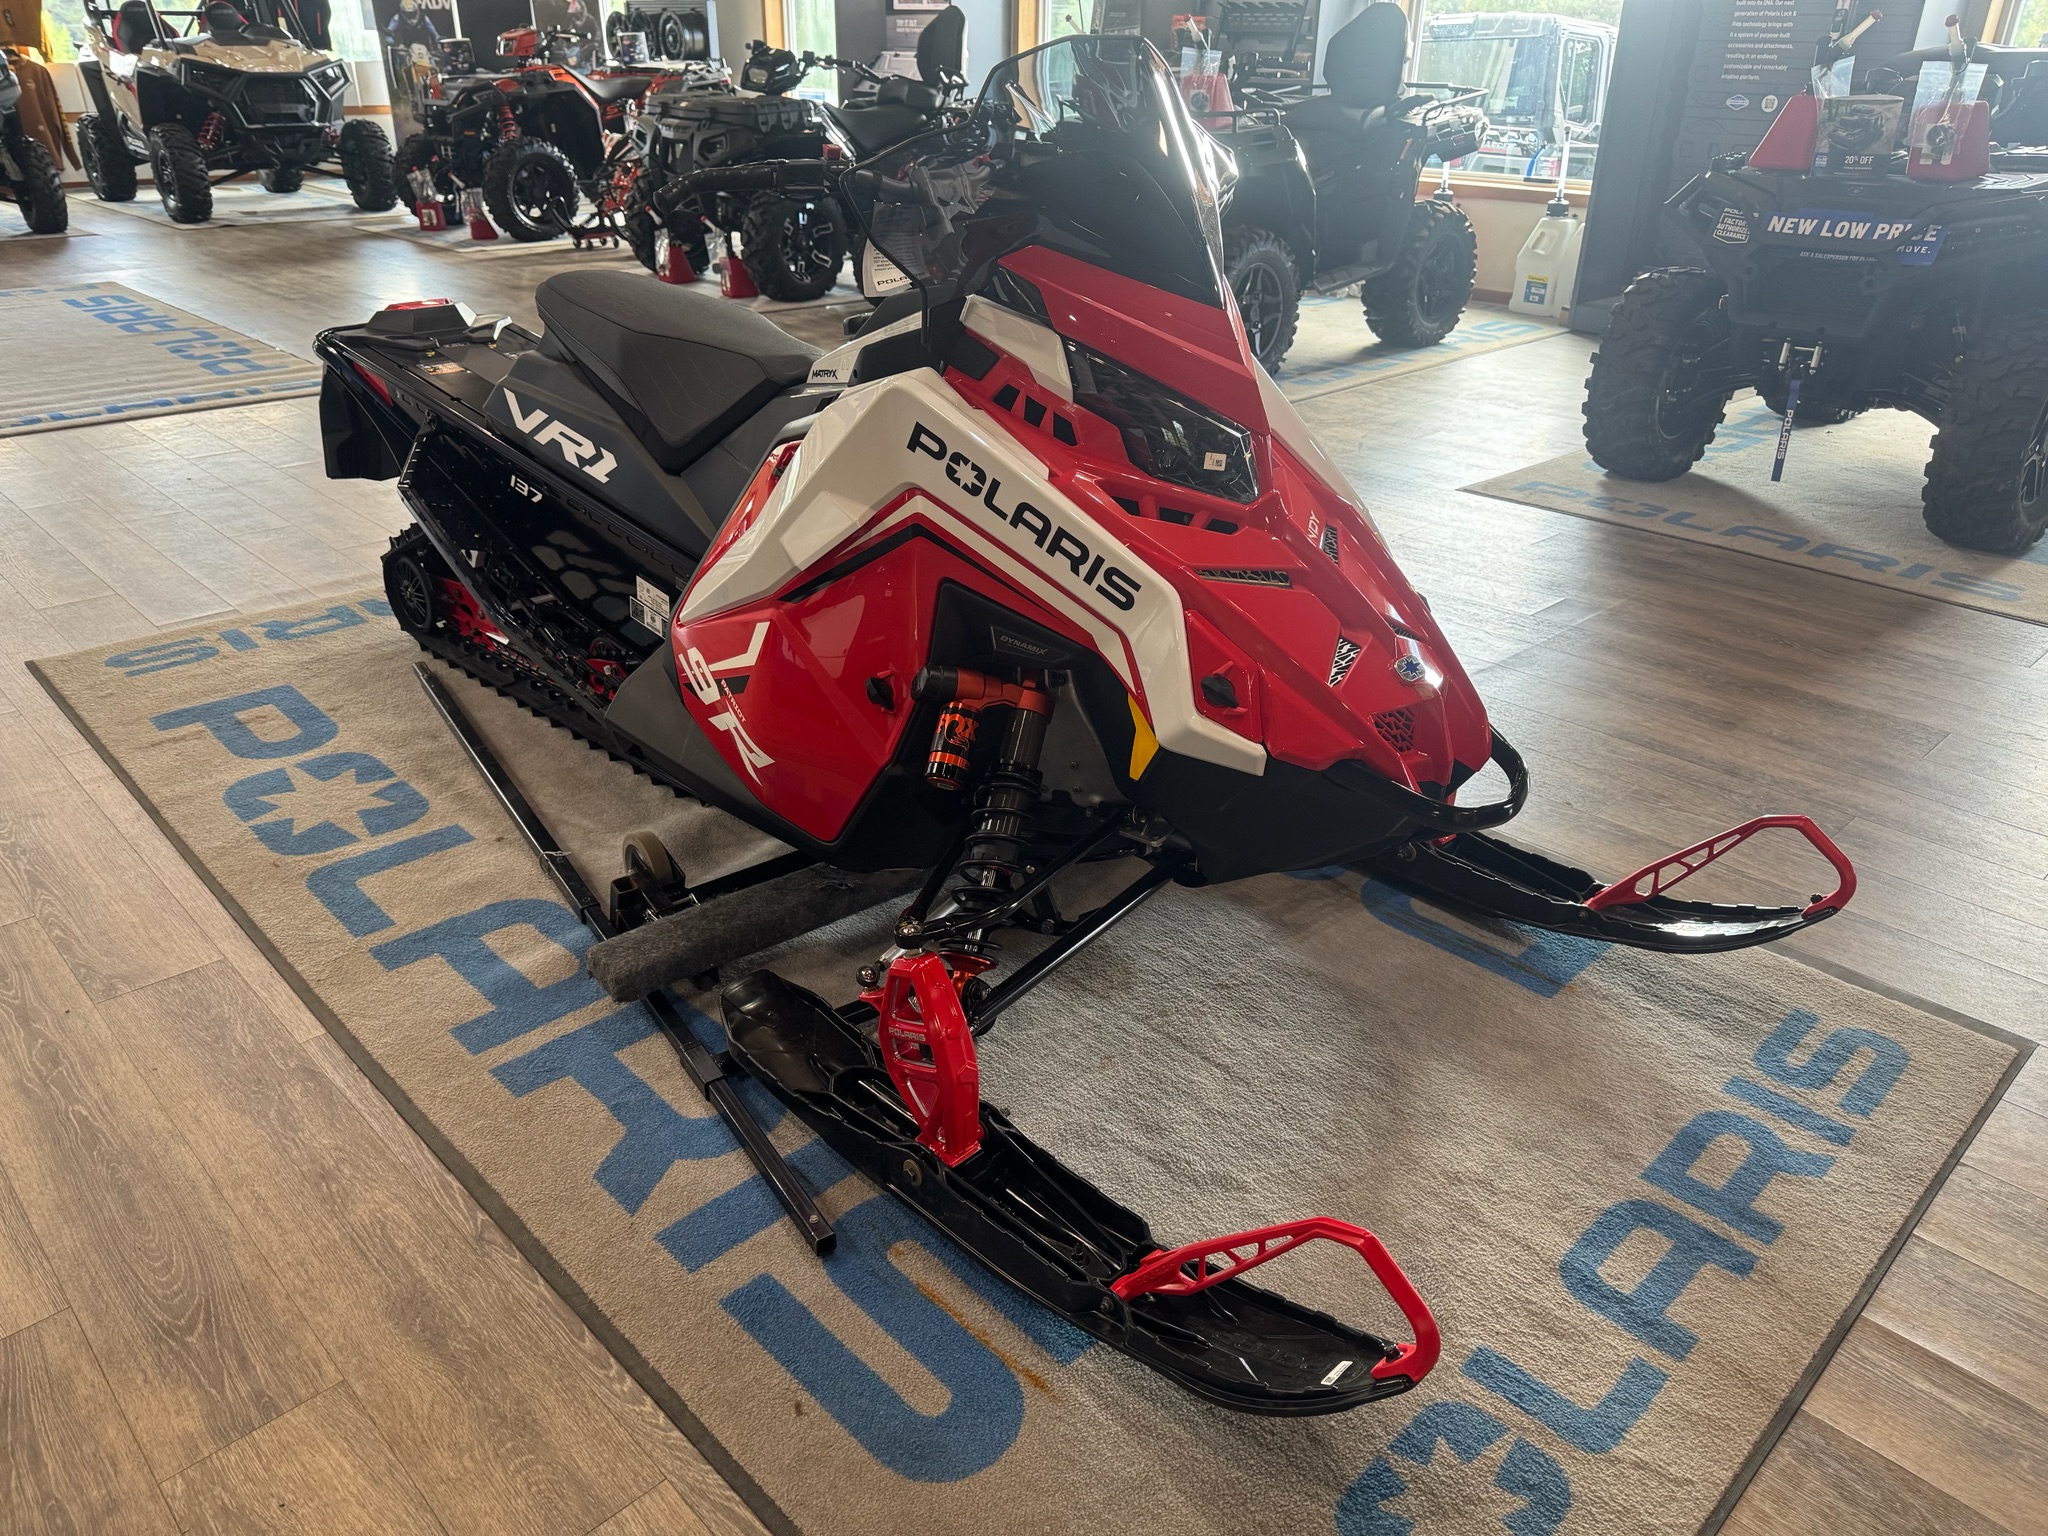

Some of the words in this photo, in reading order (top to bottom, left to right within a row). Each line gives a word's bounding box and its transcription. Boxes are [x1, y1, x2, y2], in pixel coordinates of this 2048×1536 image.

[1860, 156, 1874, 164] OFF
[1716, 223, 1750, 234] AUTHORIZE
[1716, 230, 1748, 240] CLEARANCE
[1767, 215, 1818, 236] NEW
[1820, 219, 1870, 240] LOW
[1814, 252, 1850, 260] SALESPERSON
[812, 369, 838, 380] MATRYX
[503, 387, 618, 484] VR1
[1777, 409, 1794, 460] POLARIS
[510, 474, 544, 502] 137
[906, 421, 1142, 611] POLARIS
[1512, 480, 2026, 603] POLARIS
[1000, 636, 1048, 655] DYNAMIX
[720, 678, 747, 722] PATRIOT
[888, 1026, 926, 1042] POLARIS
[1334, 1010, 1911, 1536] OLARIS
